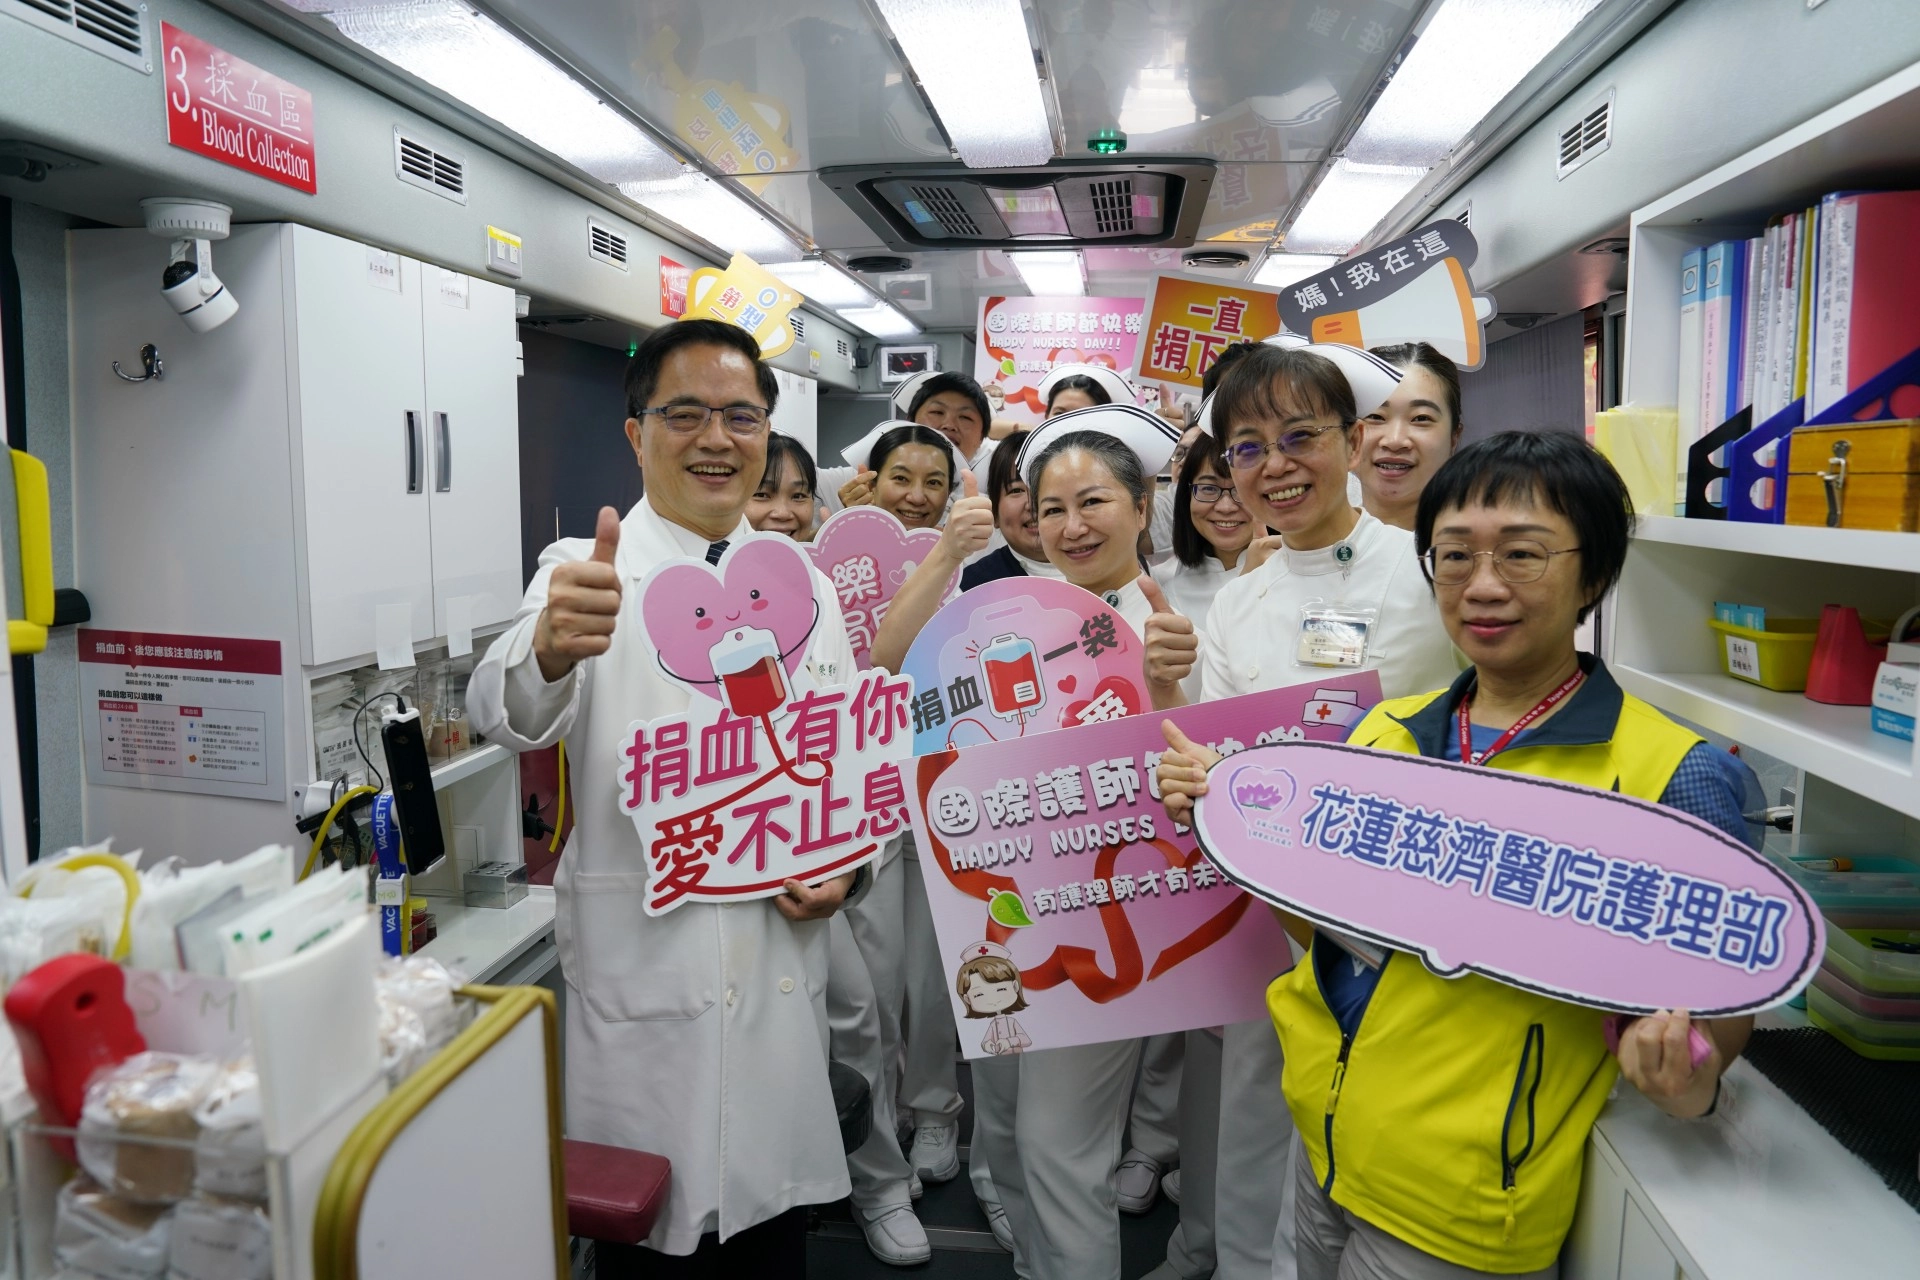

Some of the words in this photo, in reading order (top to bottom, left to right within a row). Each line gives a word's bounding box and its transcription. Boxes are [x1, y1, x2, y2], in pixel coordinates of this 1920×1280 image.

[205, 54, 302, 131] 採血區
[201, 108, 245, 159] Blood
[247, 128, 311, 182] Collection
[1294, 230, 1449, 312] 媽！我在這
[989, 337, 1027, 349] HAPPY
[1033, 337, 1077, 349] NURSES
[1084, 337, 1121, 350] DAY!!
[1151, 322, 1253, 377] 捐下
[1187, 296, 1248, 336] 一直
[96, 642, 223, 662] 捐血前、後您應該注意的事情
[910, 675, 984, 735] 捐血
[1043, 612, 1119, 663] 一袋
[375, 795, 391, 850] VACUETTE
[651, 762, 911, 909] 愛不止息
[949, 832, 1033, 873] HAPPY
[1050, 813, 1156, 857] NURSES
[1301, 786, 1789, 970] 花蓮慈濟醫院護理部
